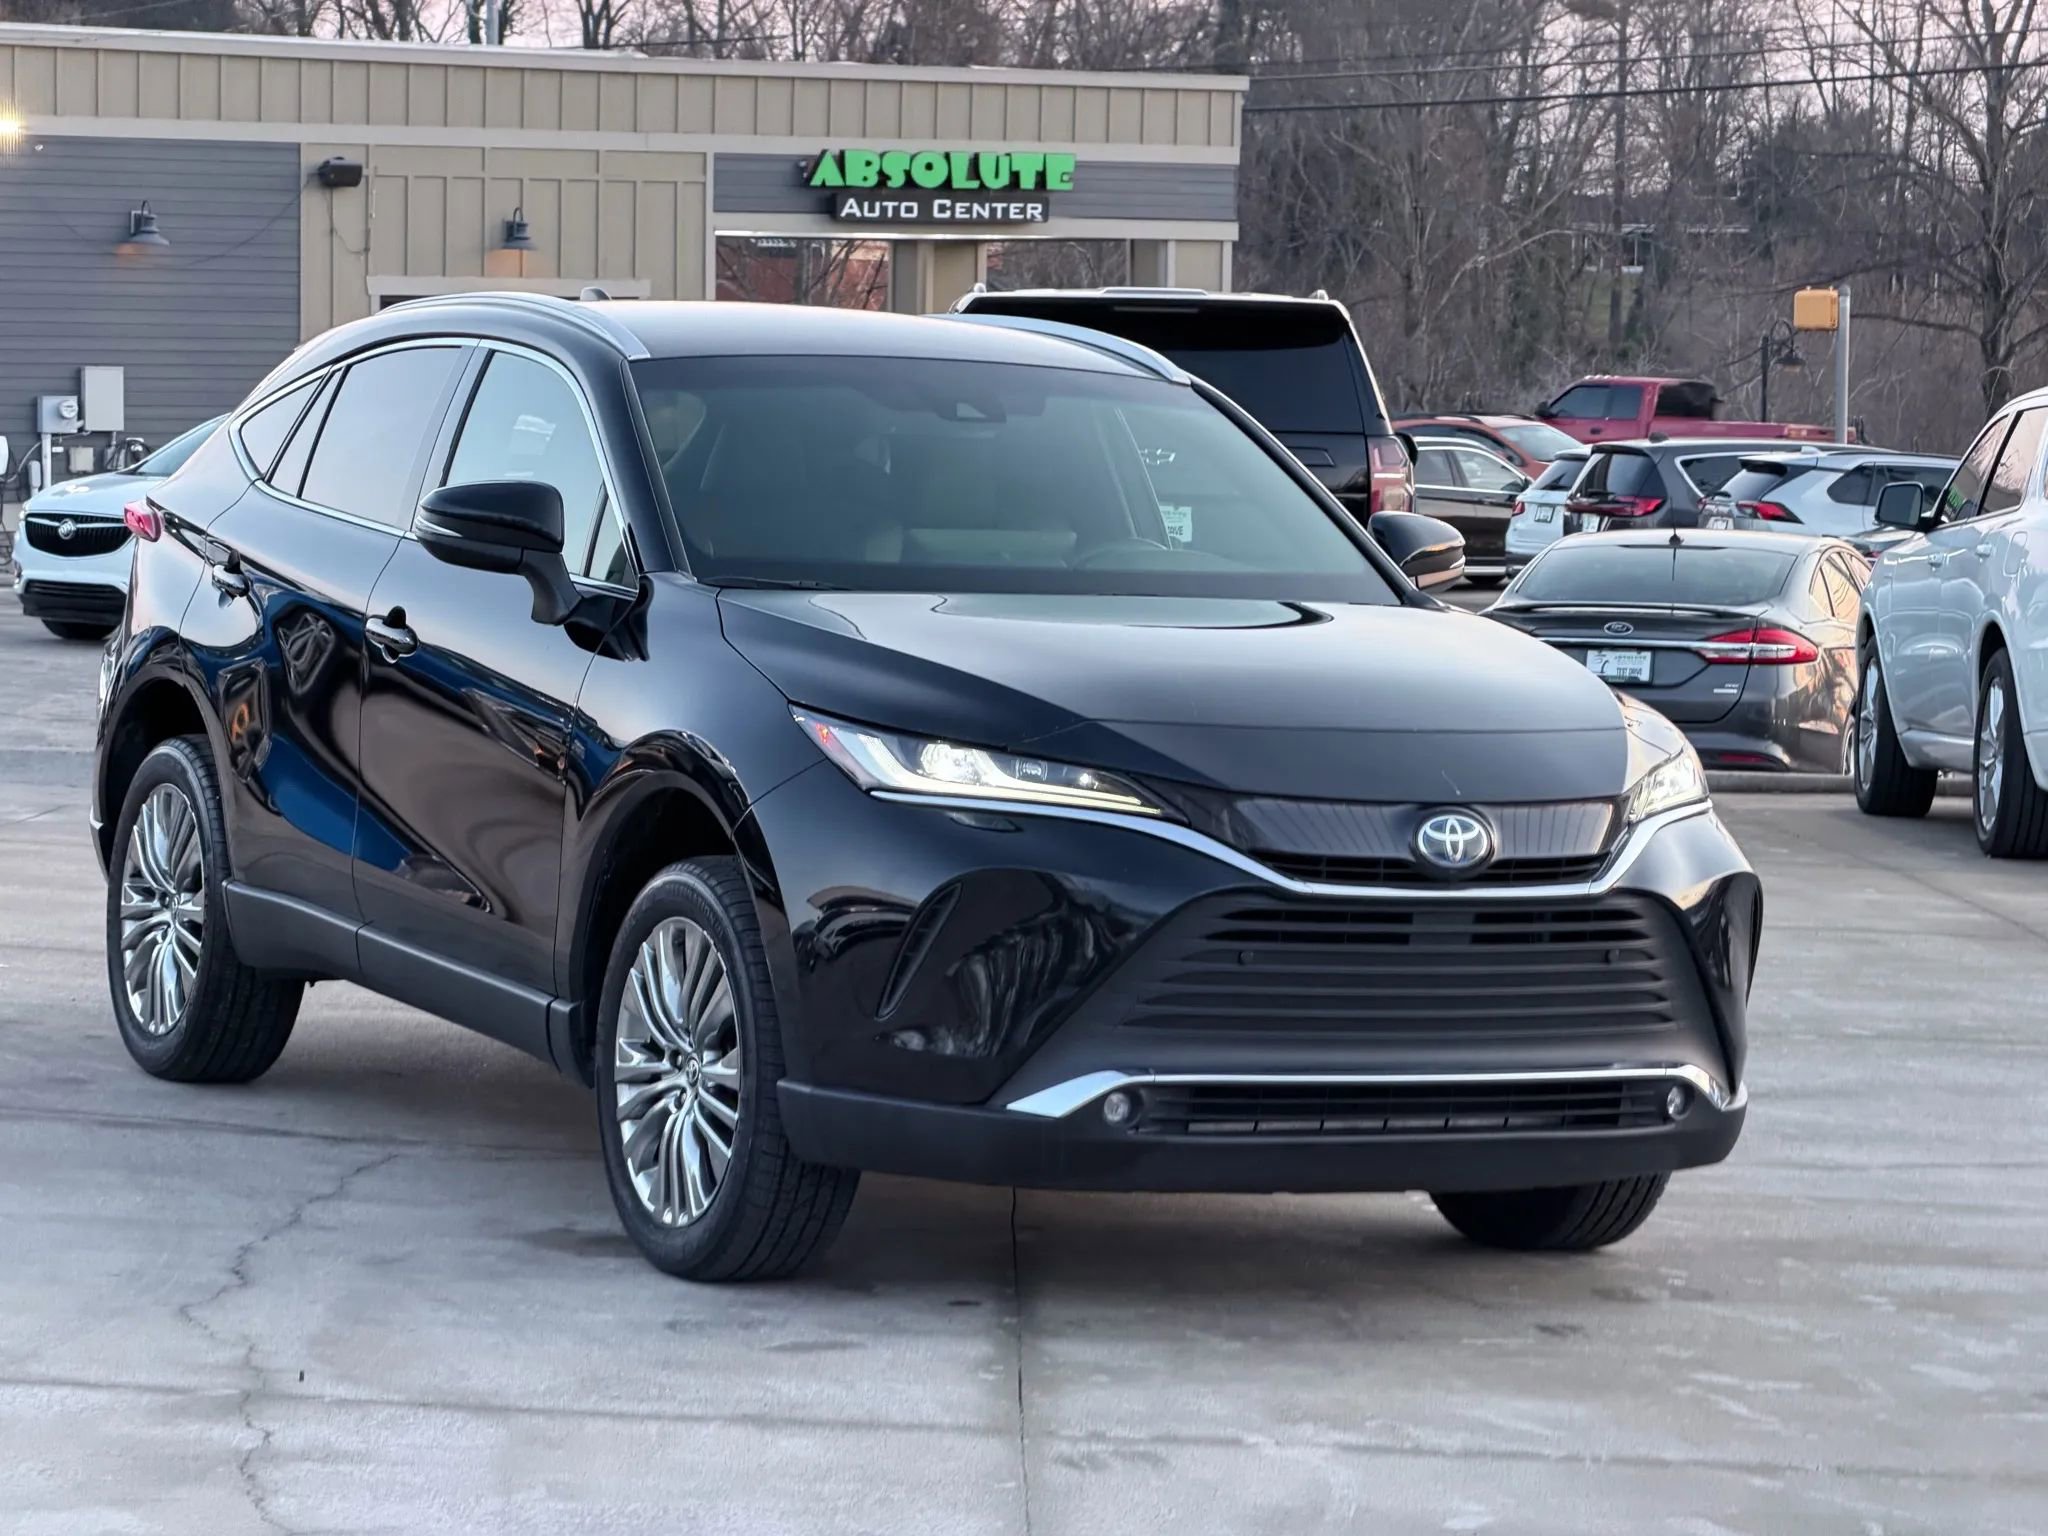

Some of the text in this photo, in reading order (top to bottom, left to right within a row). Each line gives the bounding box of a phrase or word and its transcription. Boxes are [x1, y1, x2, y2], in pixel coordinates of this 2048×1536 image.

[809, 149, 1077, 192] ABSOLUTE
[840, 198, 1043, 221] AUTO CENTER
